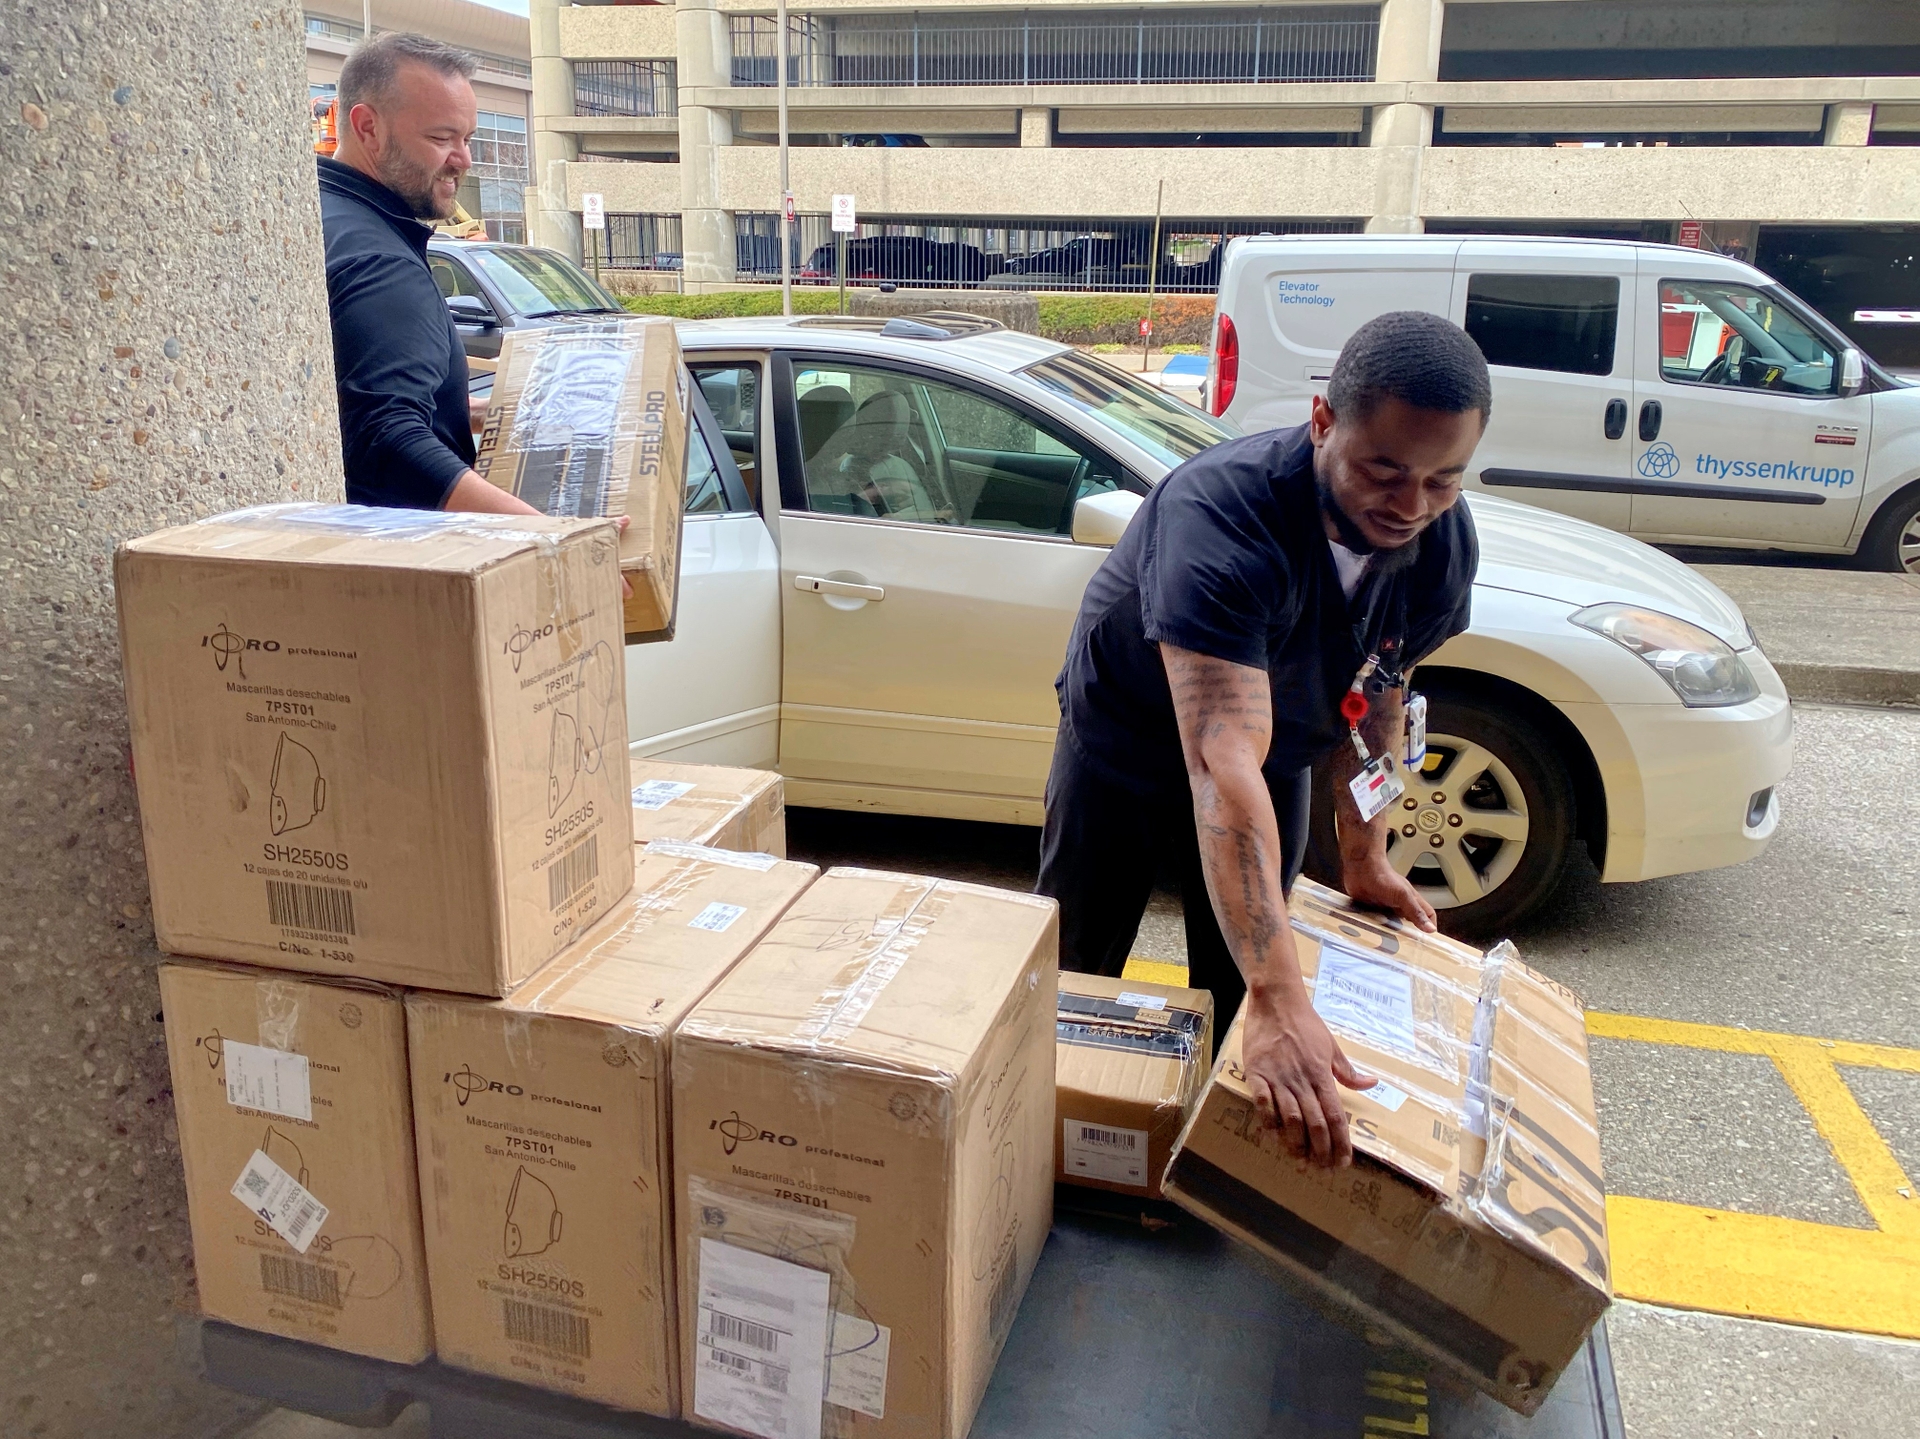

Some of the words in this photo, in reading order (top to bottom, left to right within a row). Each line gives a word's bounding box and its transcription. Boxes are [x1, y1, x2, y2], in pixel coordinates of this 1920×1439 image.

[1279, 280, 1319, 291] Elevator
[1279, 294, 1335, 307] Technology
[640, 391, 666, 477] STEELPRO
[1696, 454, 1854, 488] thyssenkrupp
[287, 646, 358, 659] profesional
[520, 667, 556, 690] Mascarillas
[545, 671, 574, 694] 7PST01
[226, 682, 285, 697] Mascarillas
[285, 687, 351, 703] desechables
[265, 700, 315, 716] 7PST01
[533, 701, 546, 713] San
[246, 712, 265, 723] San
[267, 714, 337, 731] Antonio-Chile
[545, 801, 594, 846] SH2550S
[263, 843, 349, 871] SH2550S
[531, 859, 540, 872] 12
[243, 863, 255, 873] 12
[256, 866, 281, 876] cajas
[282, 868, 294, 879] de
[296, 871, 308, 880] 20
[310, 873, 351, 886] unidades
[577, 896, 597, 917] 1-530
[320, 948, 354, 963] 1-530
[531, 1092, 601, 1113] profesional
[235, 1106, 255, 1118] San
[255, 1108, 320, 1131] Antonio-Chile
[466, 1114, 525, 1135] Mascarillas
[527, 1125, 592, 1148] desechables
[505, 1137, 554, 1155] 7PST01
[805, 1145, 885, 1168] profesional
[484, 1144, 505, 1156] San
[506, 1149, 576, 1172] Antonio-Chile
[732, 1164, 795, 1187] Mascarillas
[798, 1178, 872, 1204] desechables
[773, 1188, 829, 1210] 7PST01
[254, 1219, 332, 1251] SH0S
[498, 1264, 585, 1298] SH2550S
